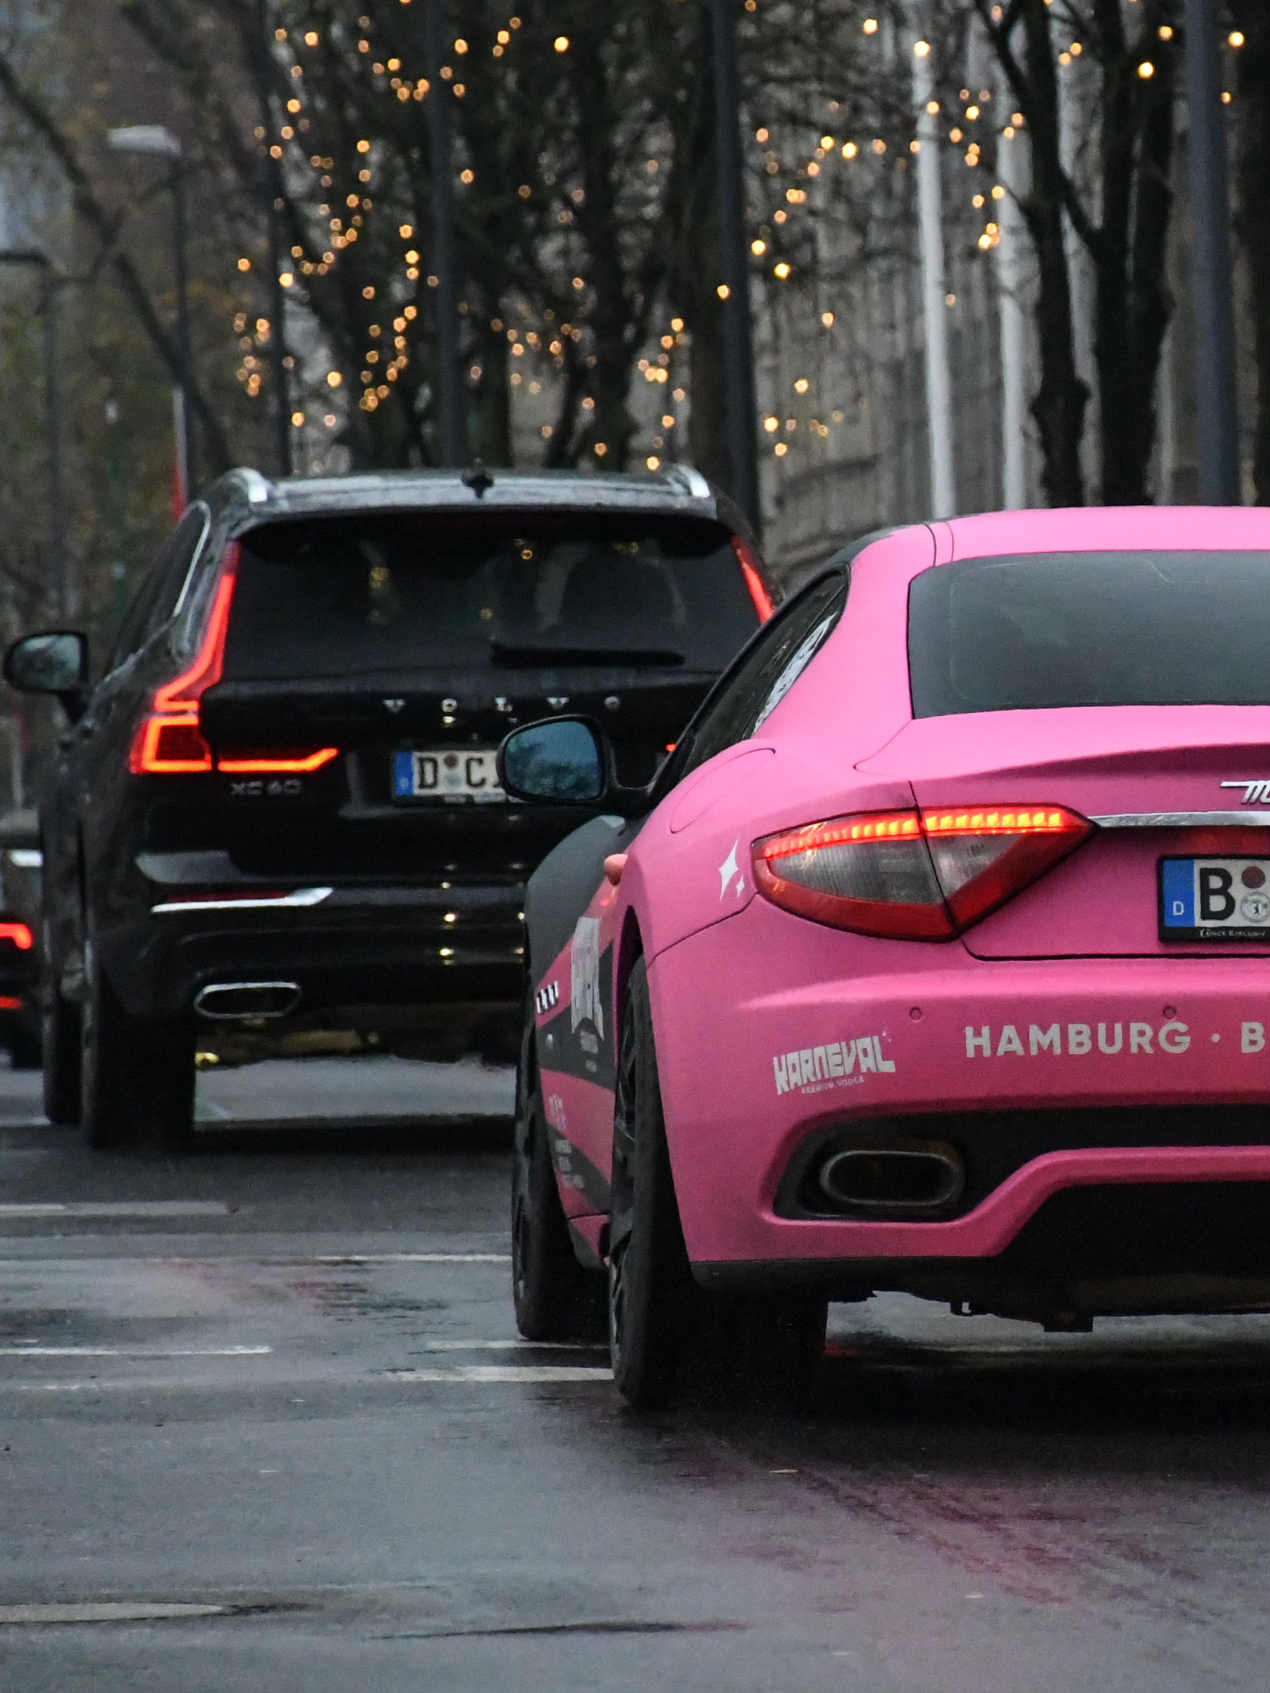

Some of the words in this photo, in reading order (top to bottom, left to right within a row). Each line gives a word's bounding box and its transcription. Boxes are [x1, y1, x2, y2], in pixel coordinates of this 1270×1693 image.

[230, 780, 302, 796] XC60
[418, 756, 439, 790] D
[1199, 867, 1237, 921] B
[965, 1021, 1191, 1058] HAMBURG
[773, 1035, 896, 1095] KARNEVAL
